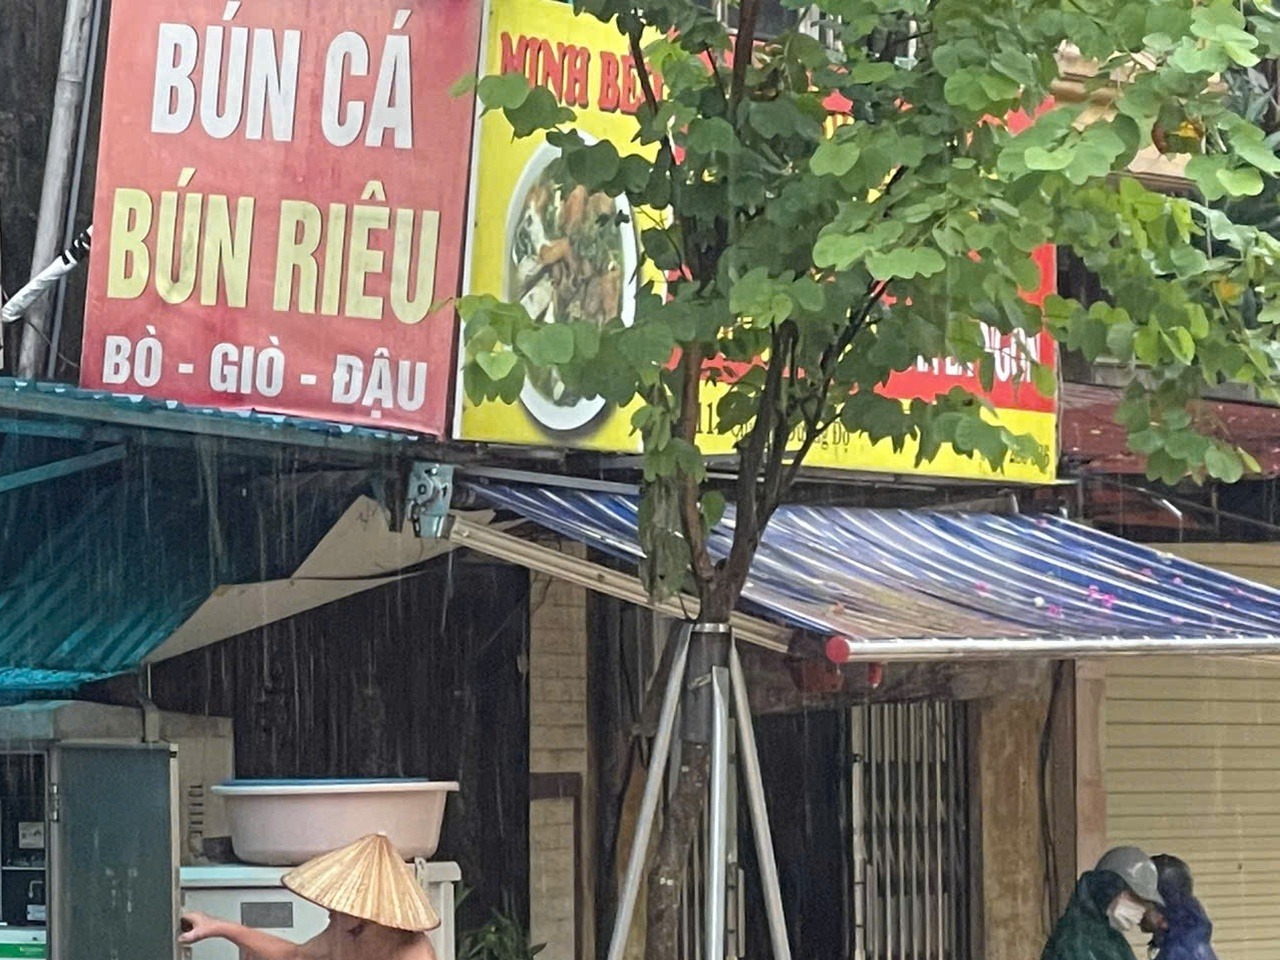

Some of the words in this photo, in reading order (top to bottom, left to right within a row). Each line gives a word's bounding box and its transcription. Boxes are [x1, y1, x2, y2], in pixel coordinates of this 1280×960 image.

[151, 1, 301, 142] BÚN
[321, 9, 412, 149] CÁ
[500, 31, 591, 109] MINH
[107, 167, 255, 308] BÚN
[273, 180, 440, 325] RIÊU
[102, 325, 164, 388] BÒ
[209, 335, 285, 398] GIÒ
[331, 346, 428, 419] ĐẬU
